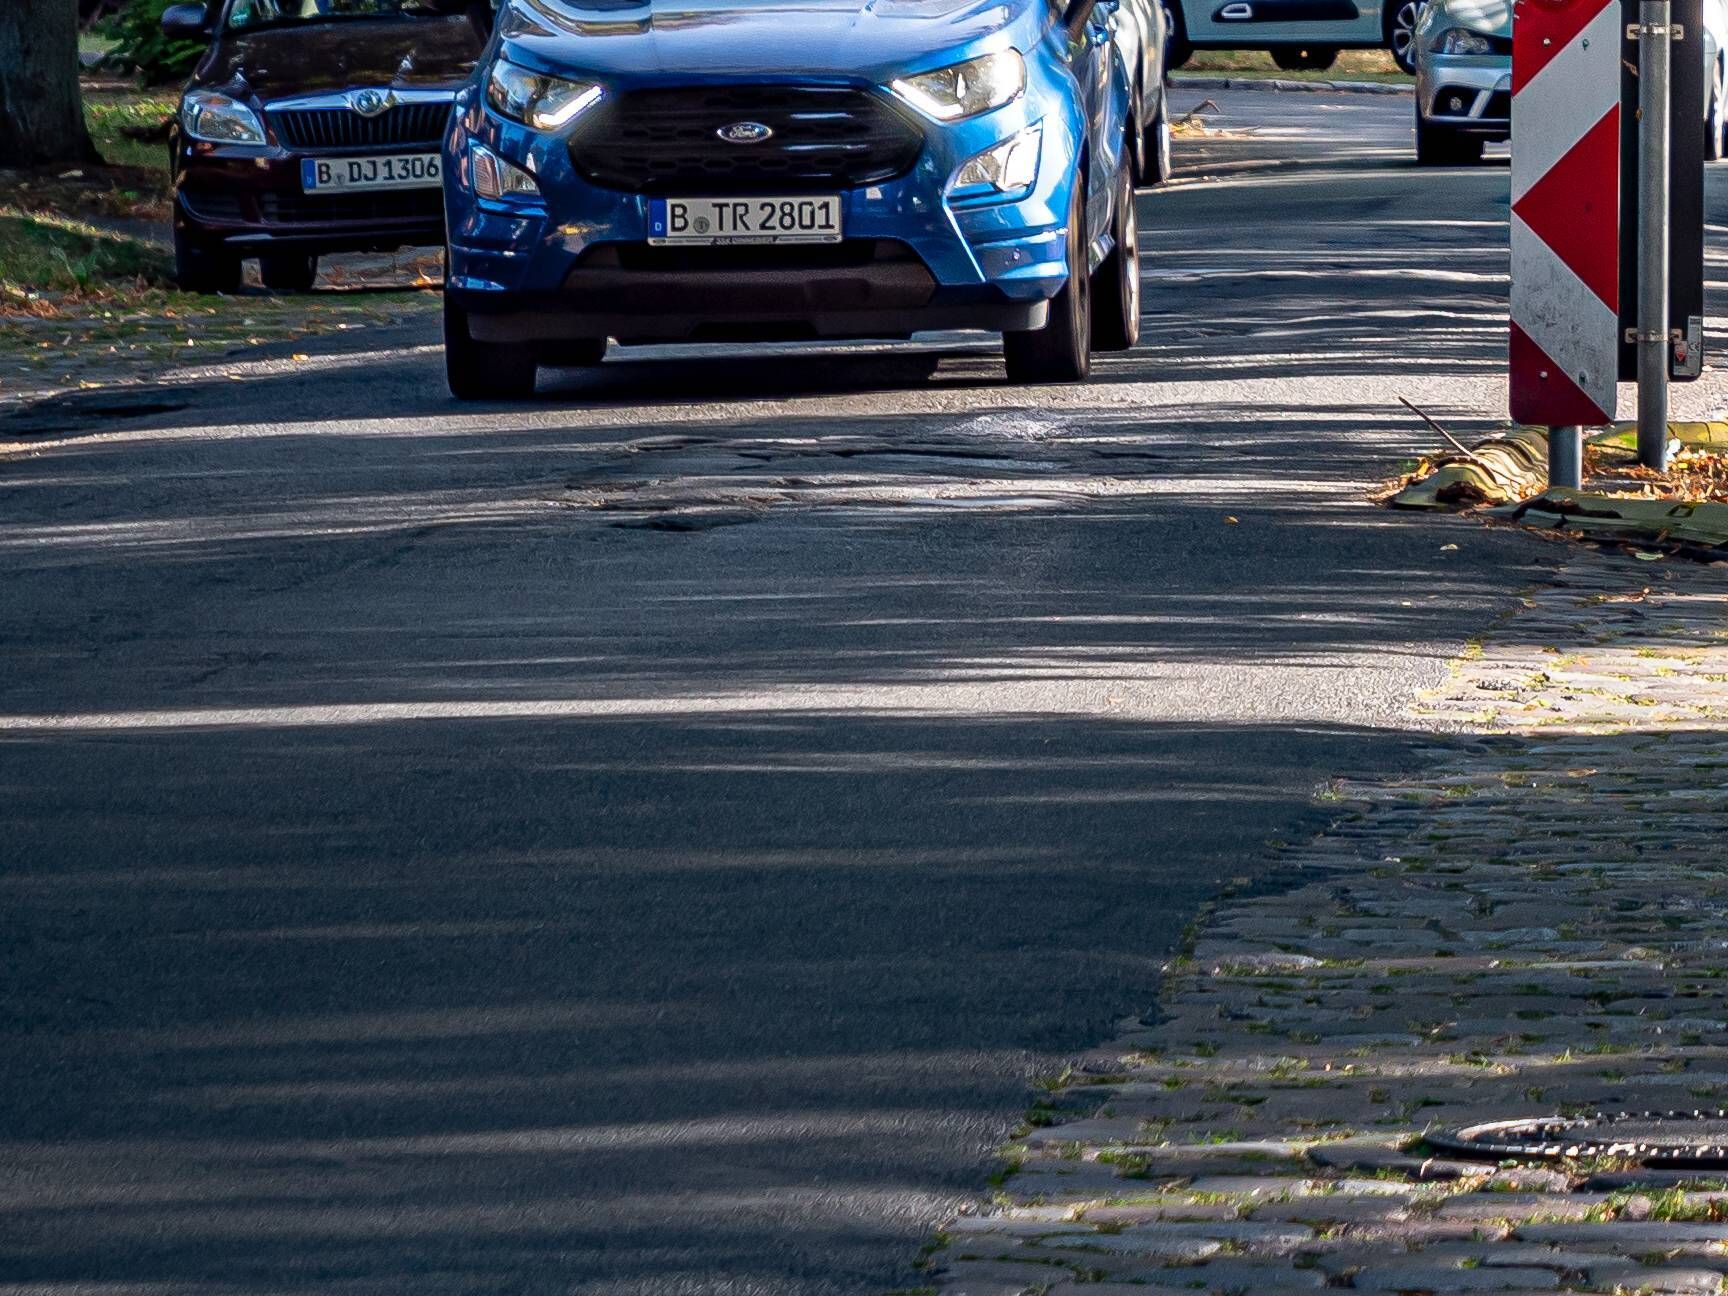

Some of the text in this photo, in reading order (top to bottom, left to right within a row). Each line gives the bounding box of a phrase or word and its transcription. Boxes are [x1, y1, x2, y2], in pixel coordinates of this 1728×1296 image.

[317, 162, 332, 184] B
[671, 203, 689, 232] B
[712, 202, 750, 231] TR
[759, 201, 835, 230] 2801
